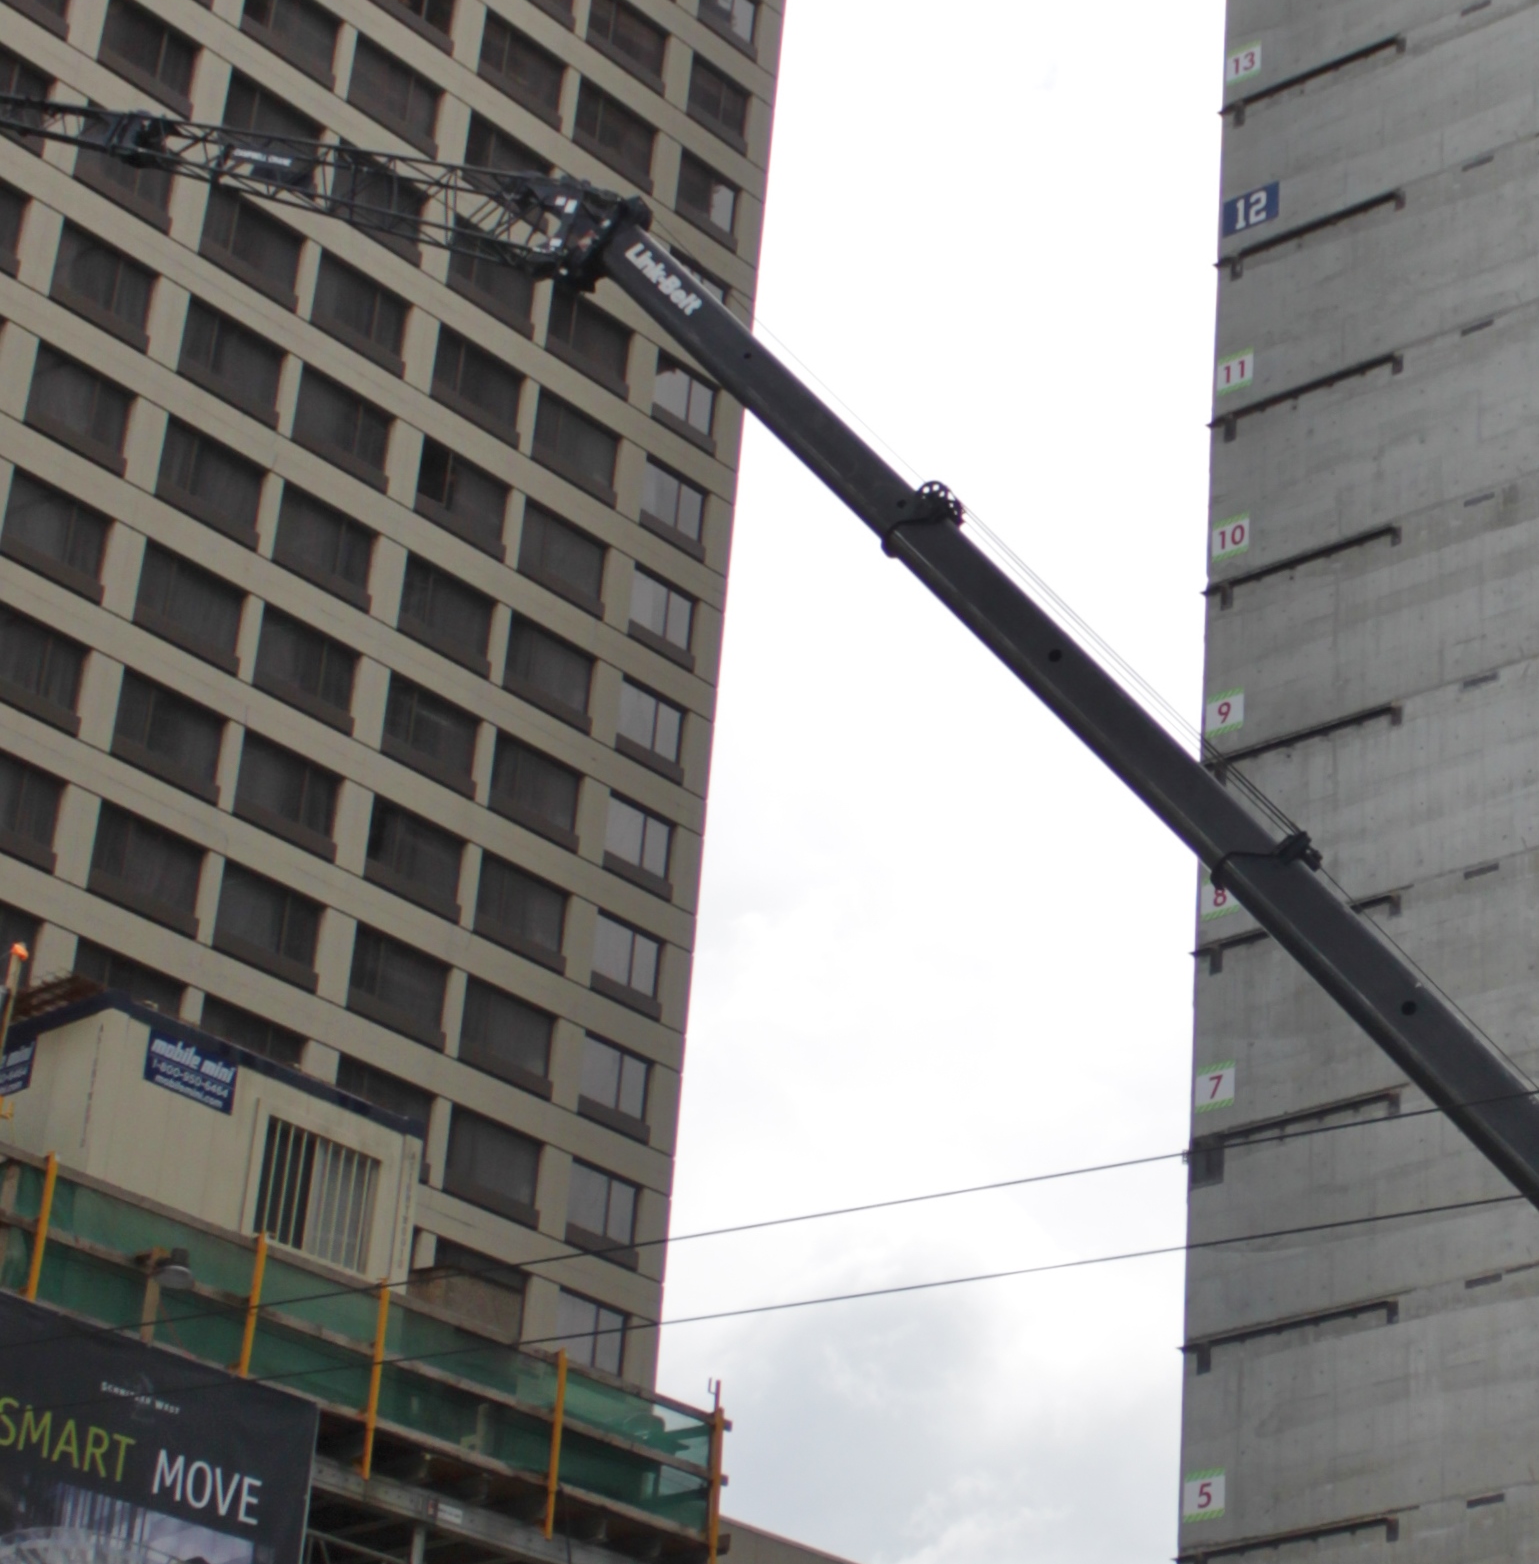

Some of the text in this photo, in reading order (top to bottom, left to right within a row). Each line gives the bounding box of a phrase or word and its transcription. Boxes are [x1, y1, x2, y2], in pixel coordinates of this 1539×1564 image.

[1233, 51, 1255, 75] 13
[1235, 189, 1267, 231] 12
[625, 242, 703, 316] Link-Belt
[1224, 359, 1245, 384] 11
[1219, 523, 1245, 550] 10
[1217, 701, 1231, 724] 9
[1213, 885, 1227, 907] 8
[151, 1037, 237, 1084] mobile mini
[1209, 1074, 1223, 1099] 7
[0, 1396, 263, 1526] SMART MOVE
[1197, 1482, 1211, 1509] 5
